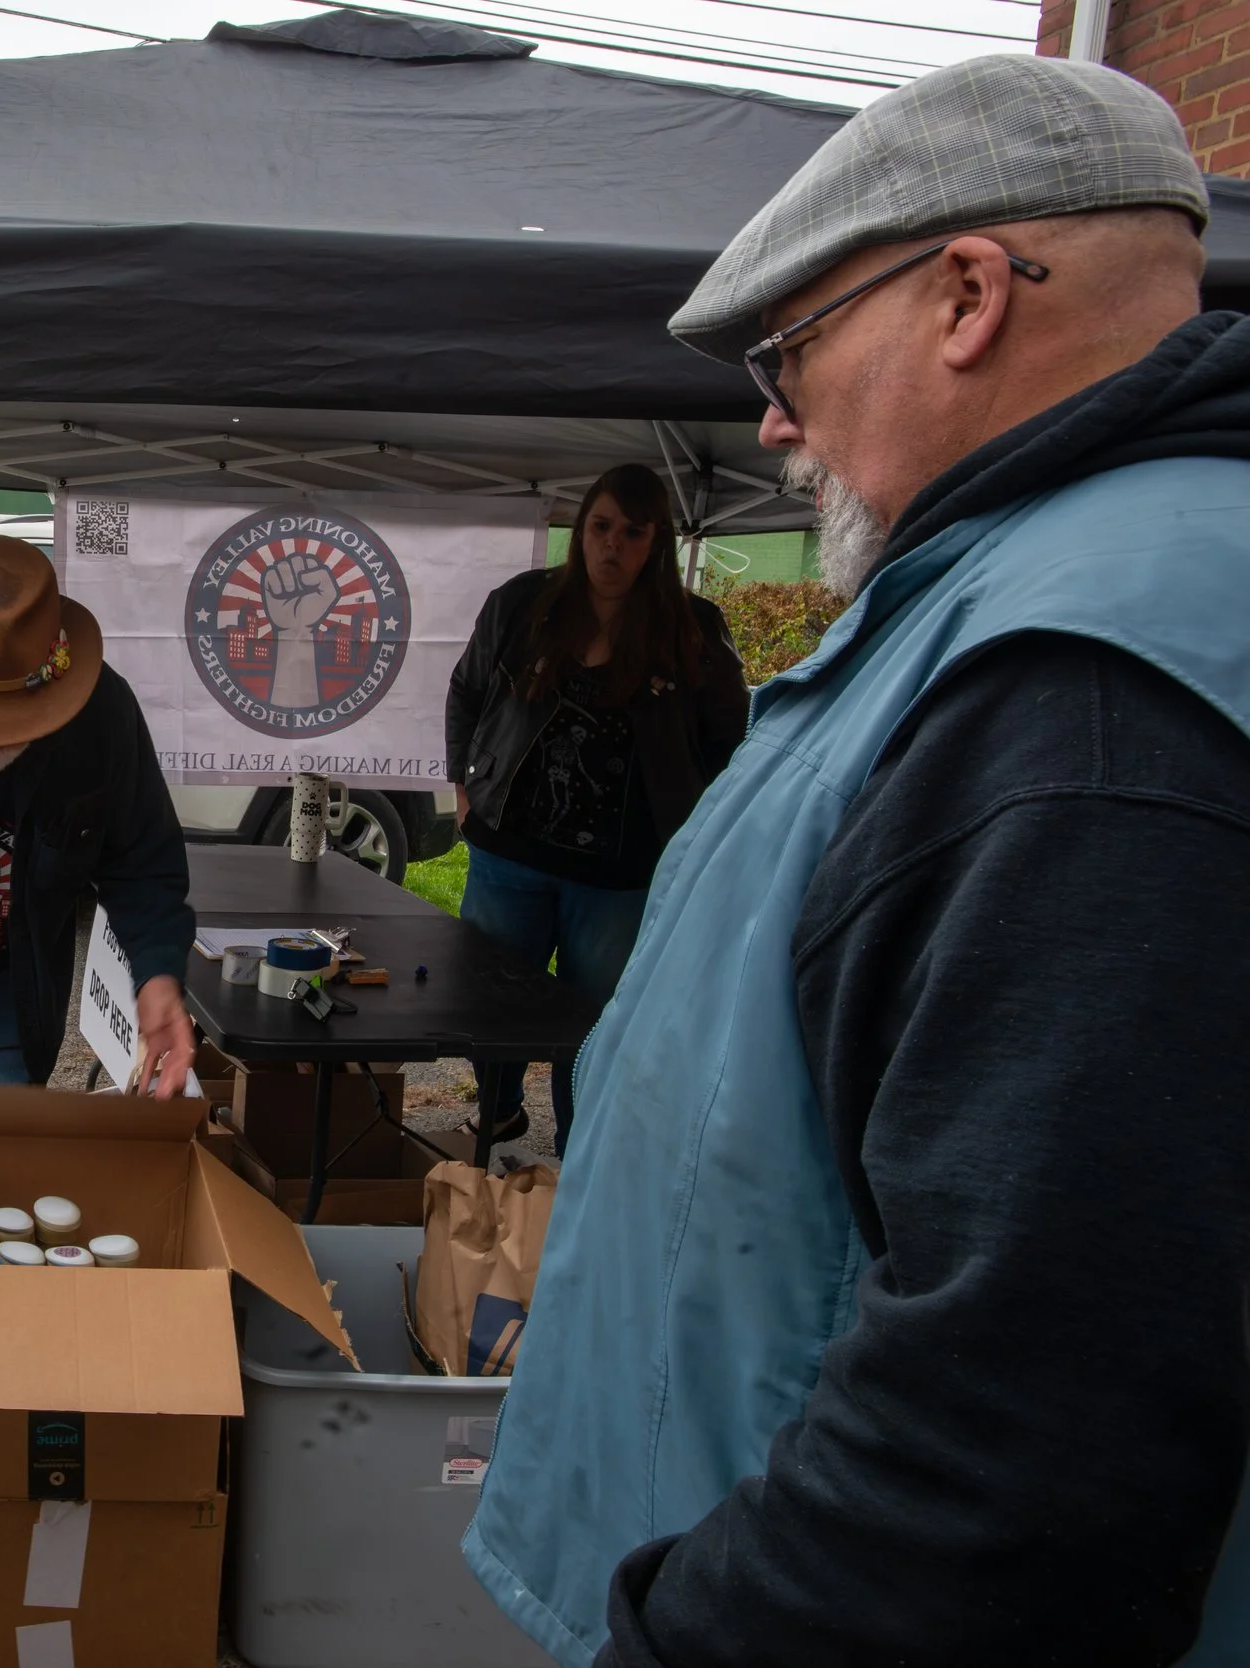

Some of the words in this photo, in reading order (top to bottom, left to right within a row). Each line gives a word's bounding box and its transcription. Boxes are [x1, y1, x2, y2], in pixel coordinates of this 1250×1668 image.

[302, 802, 322, 810] DOG
[89, 968, 110, 1018] DROP
[109, 1000, 133, 1058] HERE
[36, 1432, 78, 1448] prime
